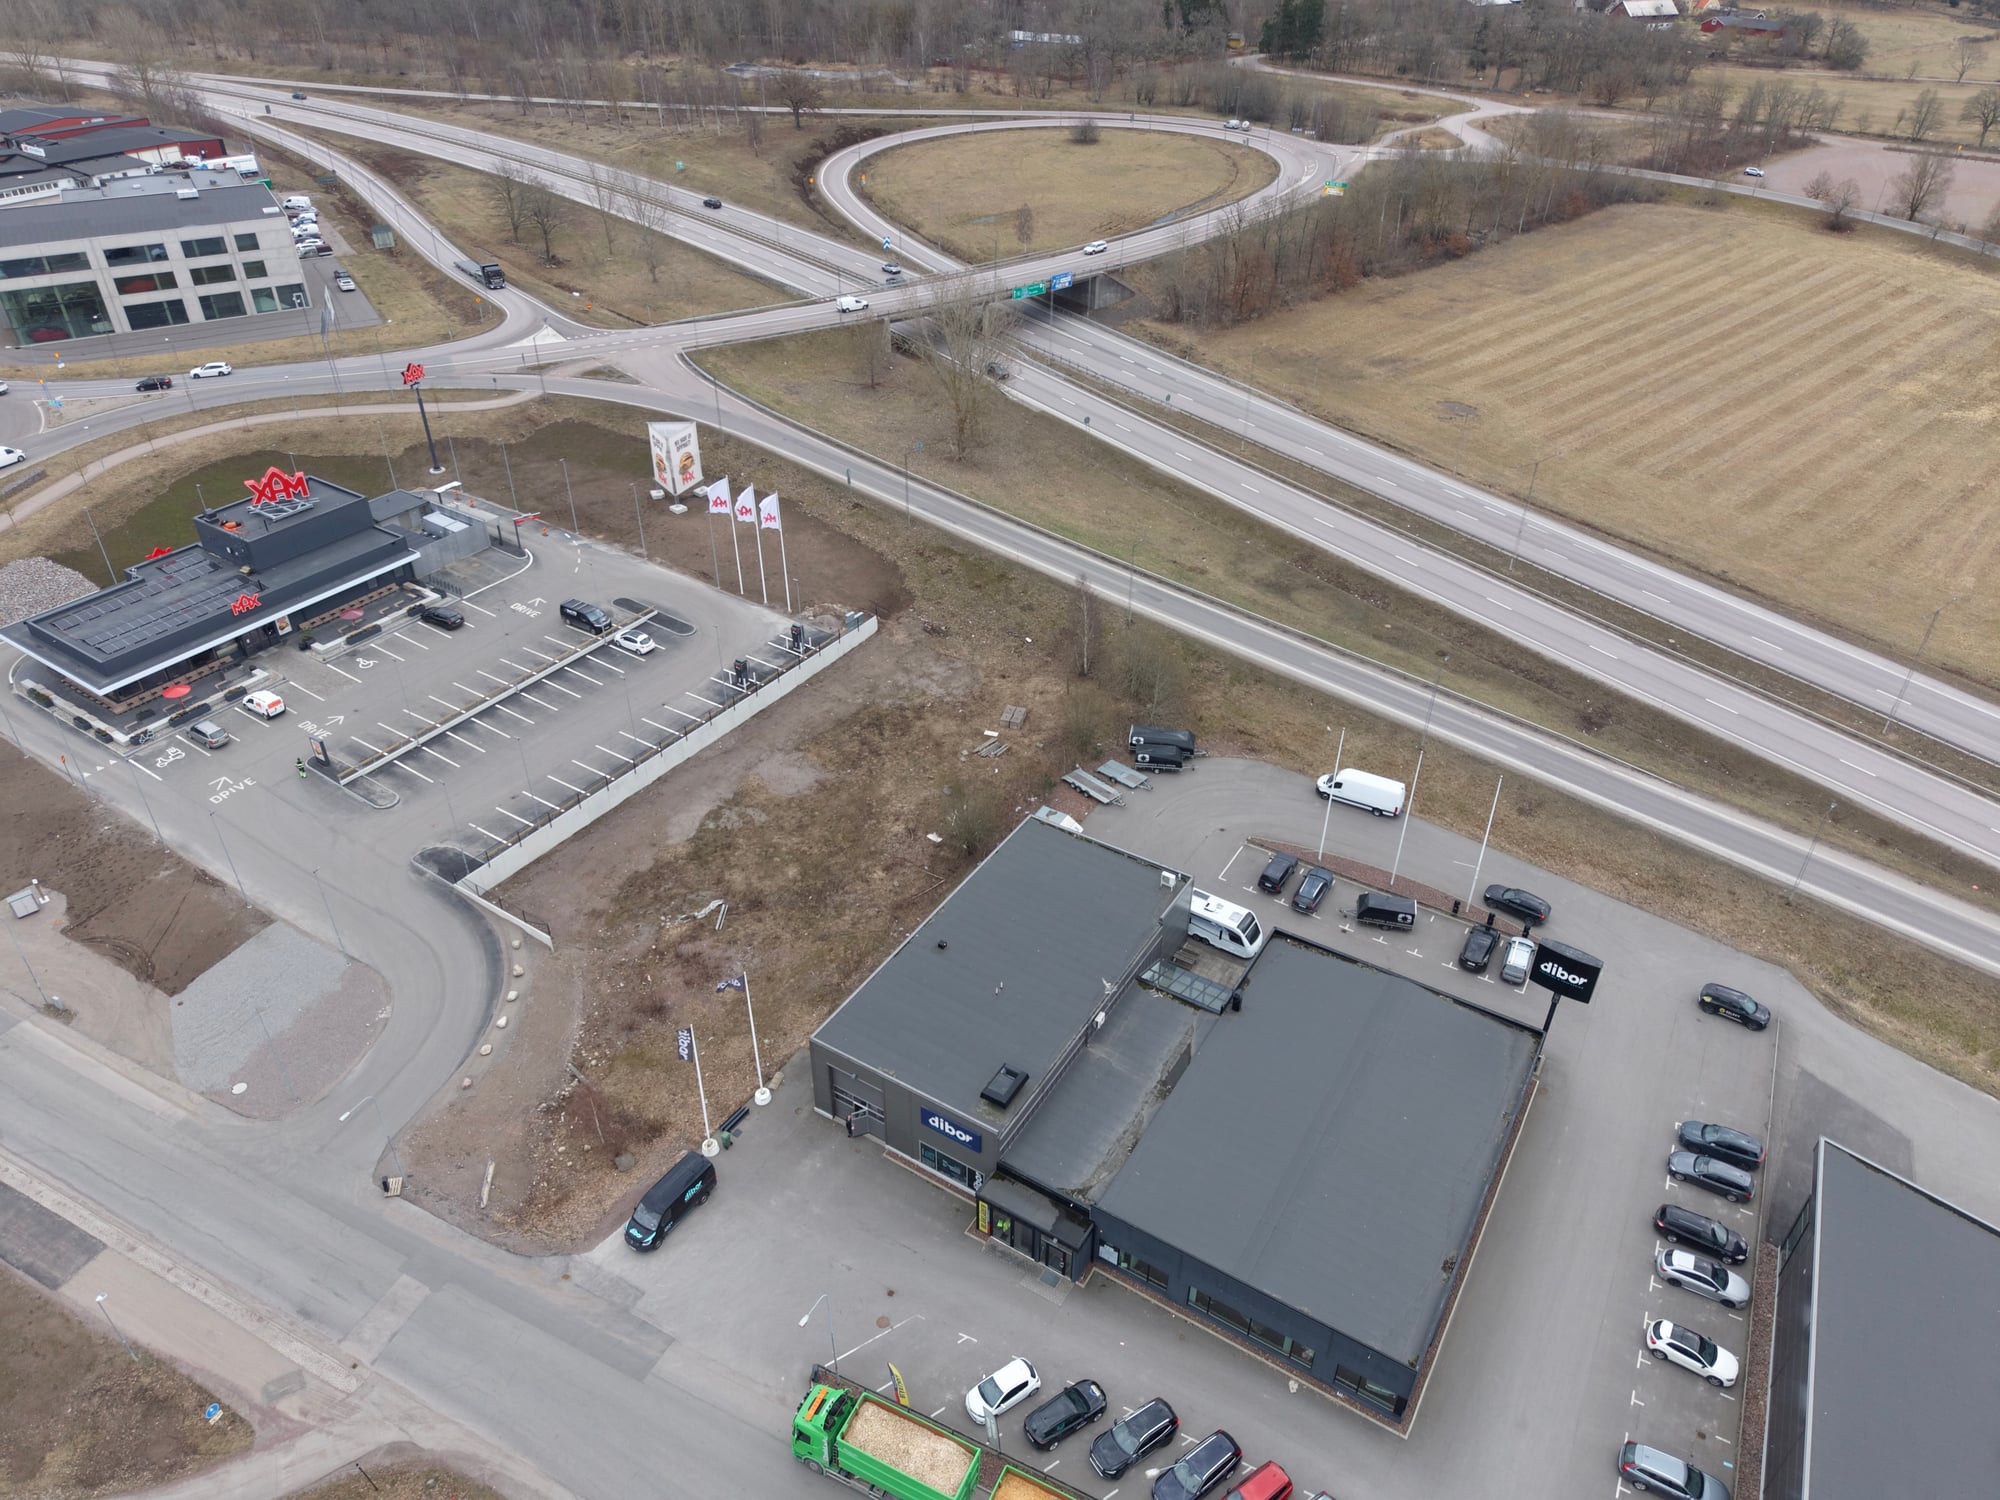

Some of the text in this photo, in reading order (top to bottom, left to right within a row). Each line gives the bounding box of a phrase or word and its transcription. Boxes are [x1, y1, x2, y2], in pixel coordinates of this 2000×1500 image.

[230, 593, 262, 616] MAX
[510, 602, 541, 618] DRIVE
[298, 720, 332, 740] DRIVE
[209, 777, 256, 804] DRIVE
[1540, 962, 1588, 985] dibor
[678, 1029, 691, 1060] dibor
[928, 1116, 973, 1142] dibor
